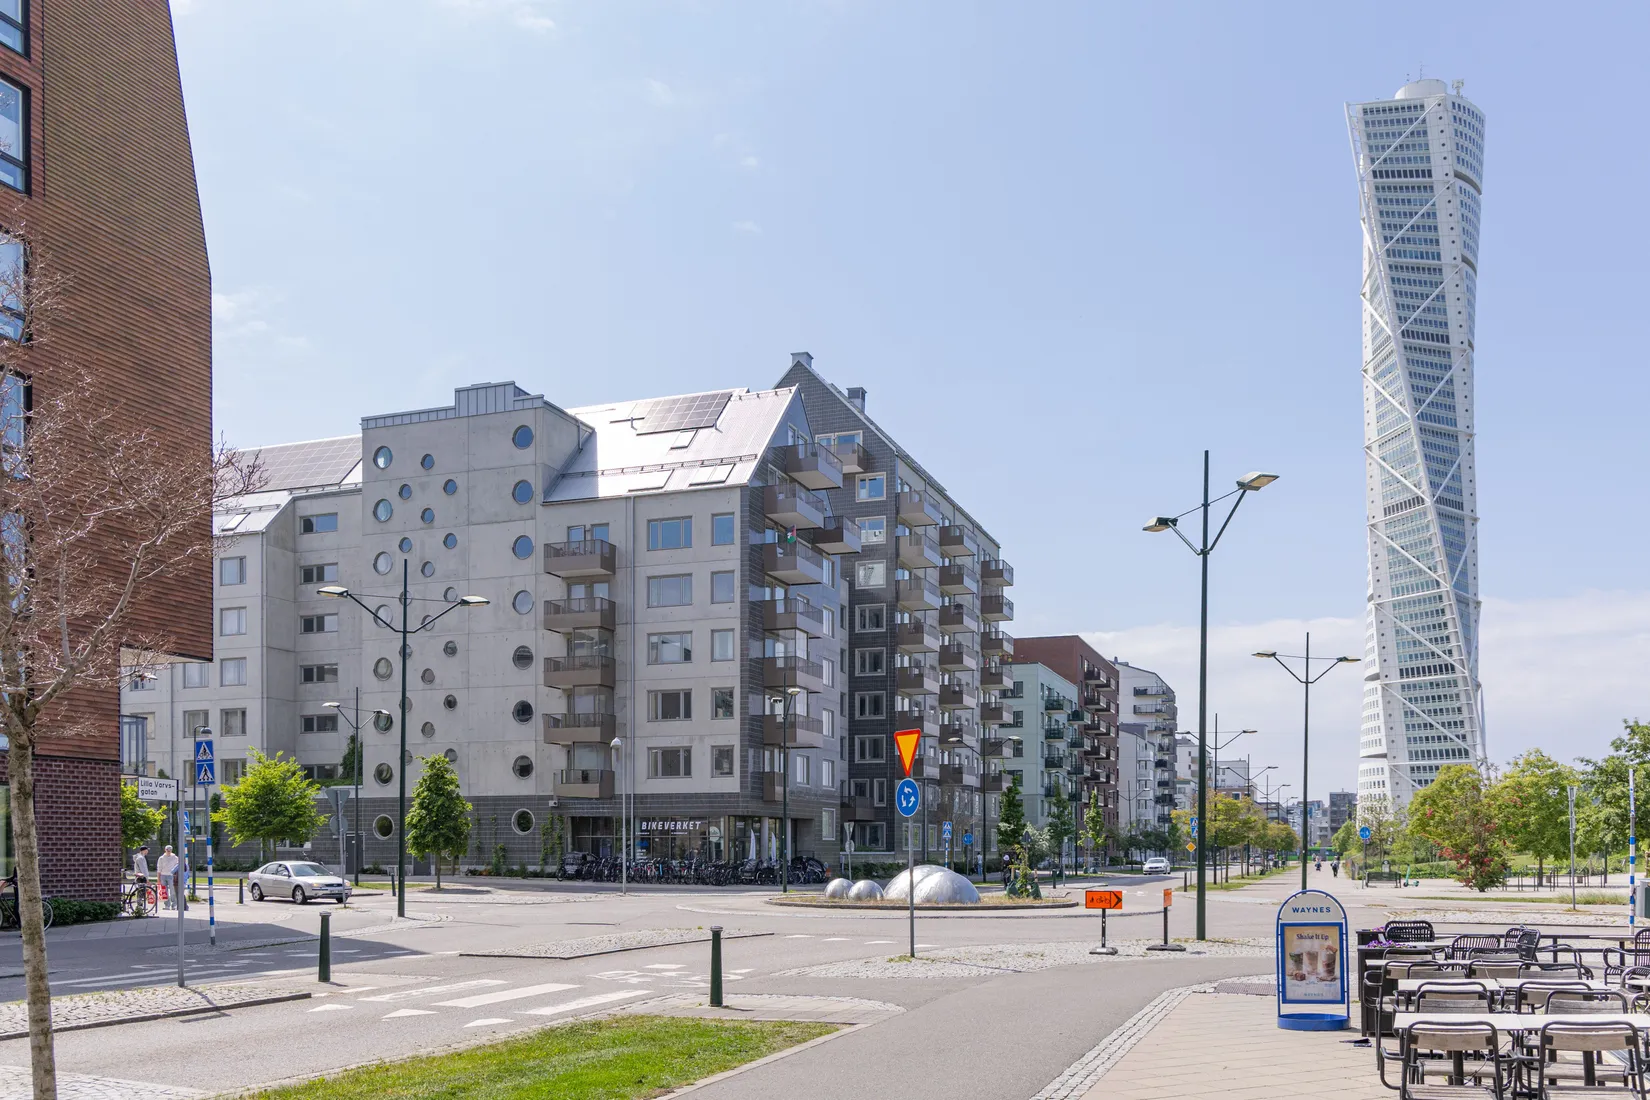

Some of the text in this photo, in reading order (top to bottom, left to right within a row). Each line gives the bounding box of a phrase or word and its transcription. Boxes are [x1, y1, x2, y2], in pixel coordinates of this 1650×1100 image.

[154, 781, 175, 789] Varvs-
[641, 821, 701, 830] BIKEVERKET
[1321, 933, 1329, 941] Up
